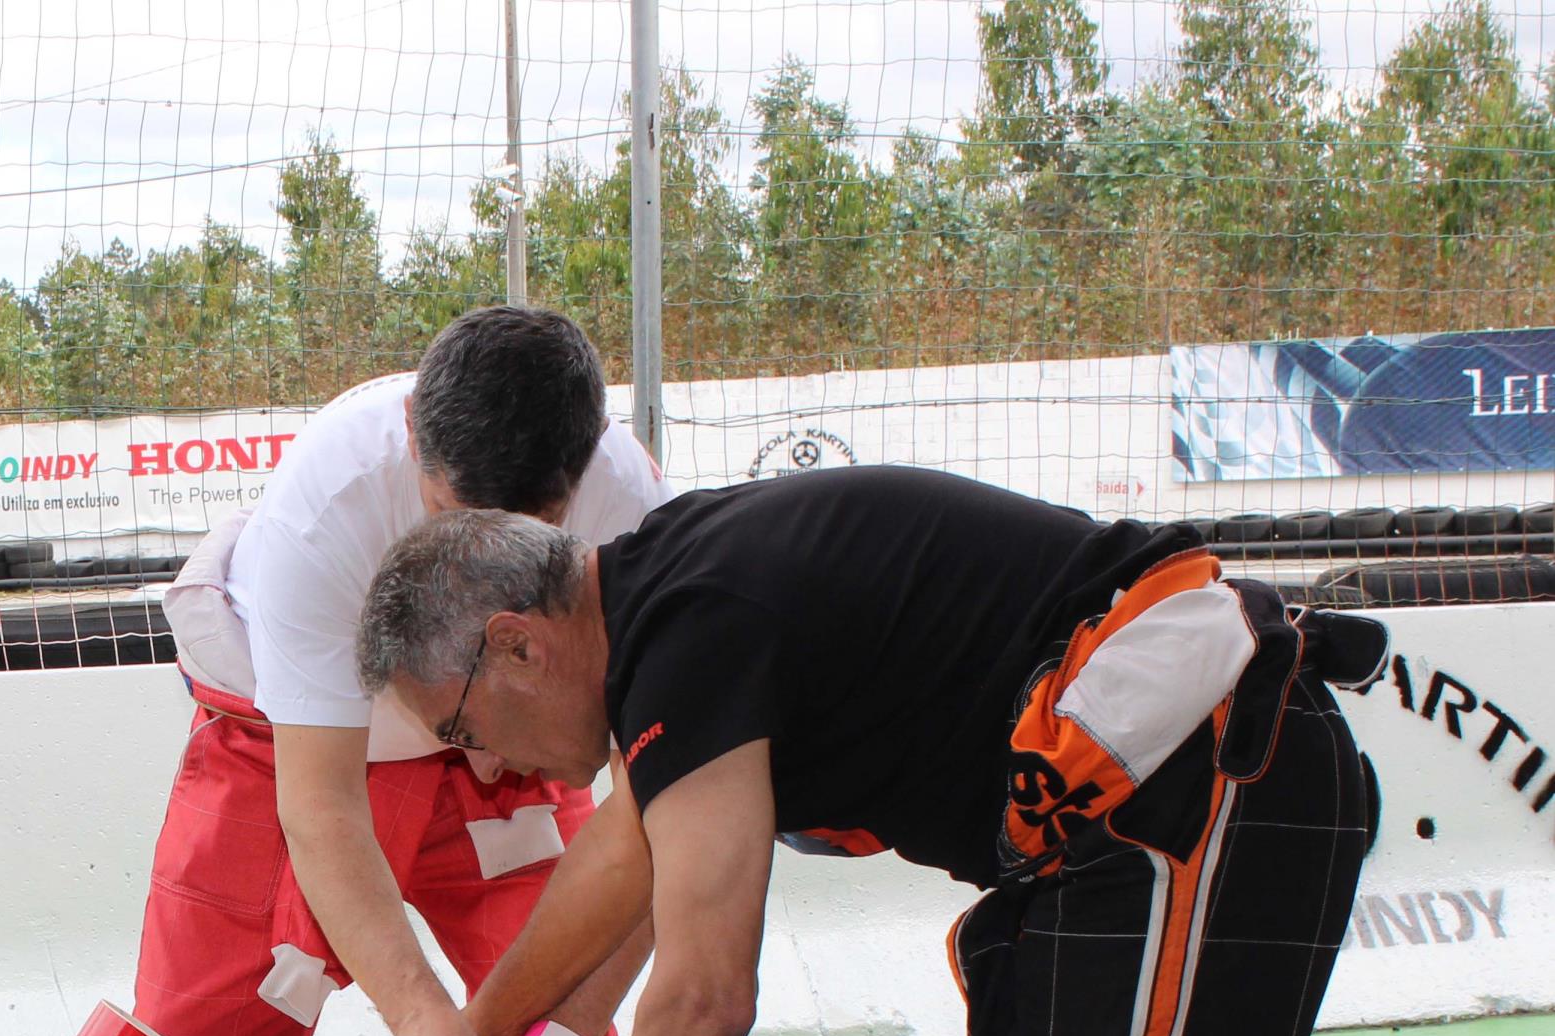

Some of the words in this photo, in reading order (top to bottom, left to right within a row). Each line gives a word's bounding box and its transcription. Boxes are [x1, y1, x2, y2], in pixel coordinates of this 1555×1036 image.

[1461, 367, 1555, 417] LEI
[44, 497, 63, 511] em
[65, 491, 120, 509] exclusivo
[149, 488, 183, 505] The
[188, 485, 244, 504] Power
[248, 484, 266, 500] of
